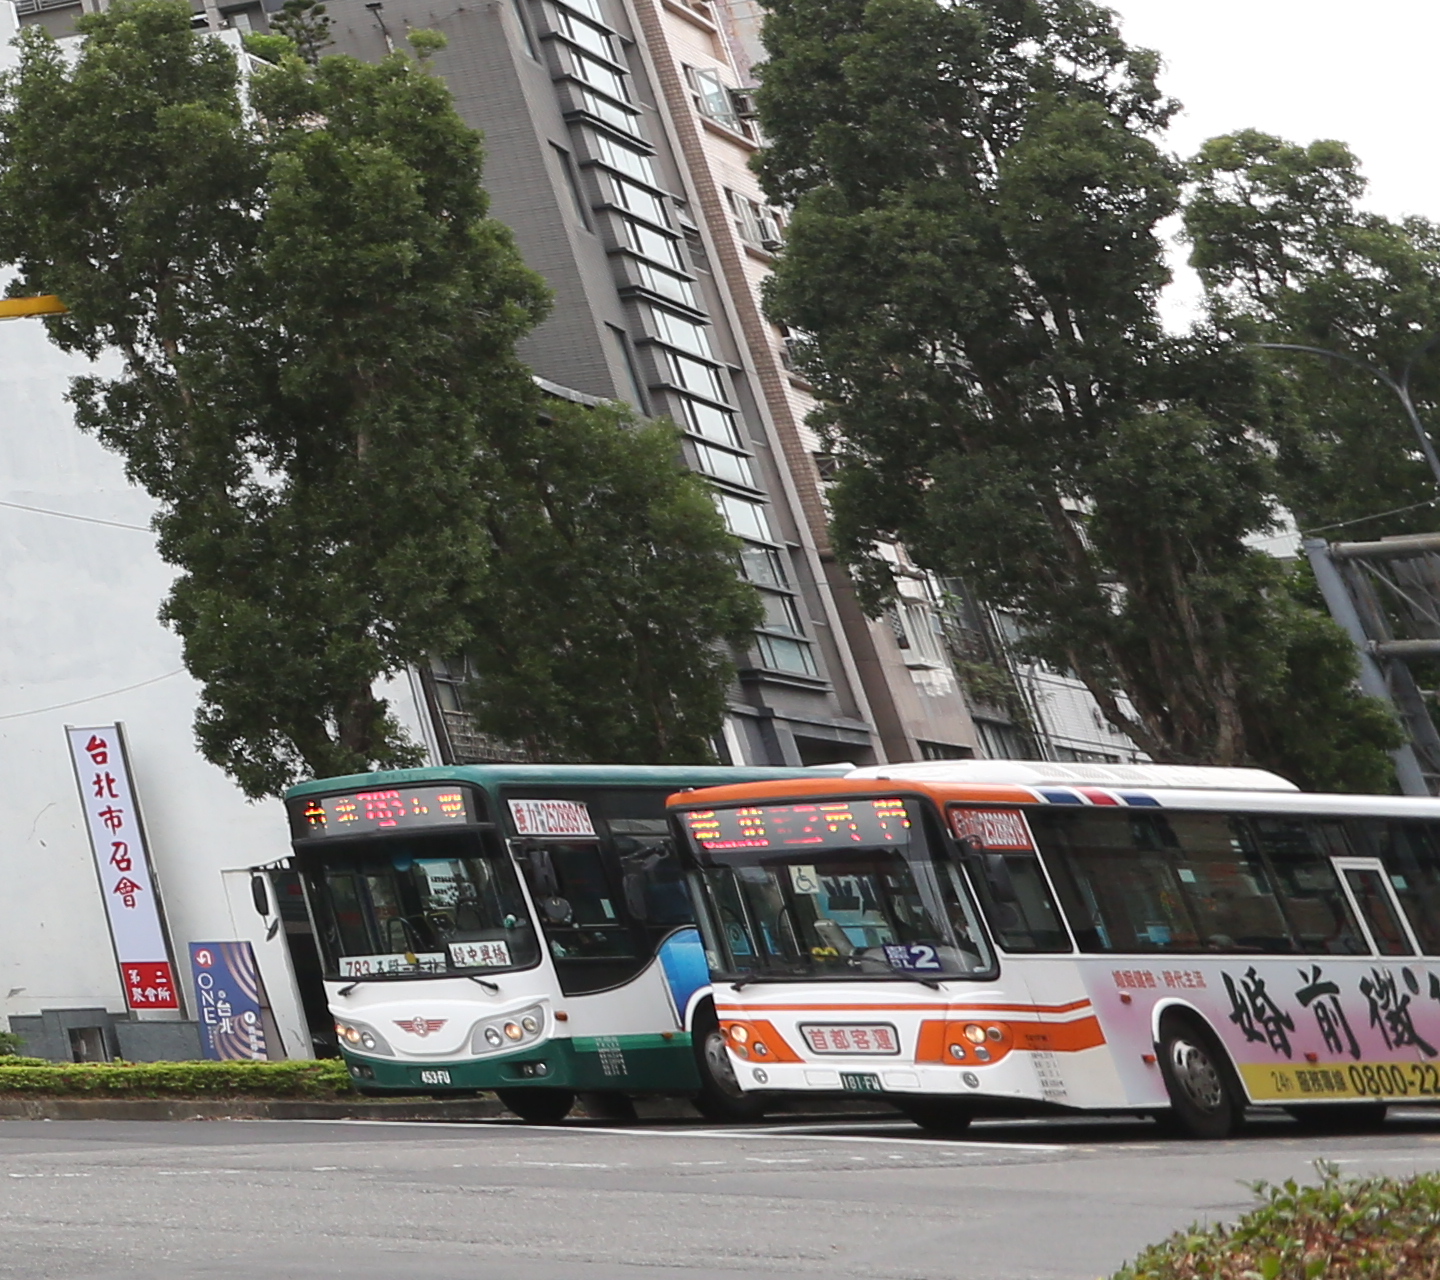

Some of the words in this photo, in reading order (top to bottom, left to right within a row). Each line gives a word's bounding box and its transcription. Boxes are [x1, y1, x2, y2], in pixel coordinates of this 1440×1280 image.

[84, 734, 143, 909] 台北市召會
[910, 945, 940, 968] 2
[128, 970, 167, 984] 第二
[198, 973, 217, 1024] ONE
[217, 1000, 235, 1034] 台北
[808, 1028, 894, 1050] 首都客運
